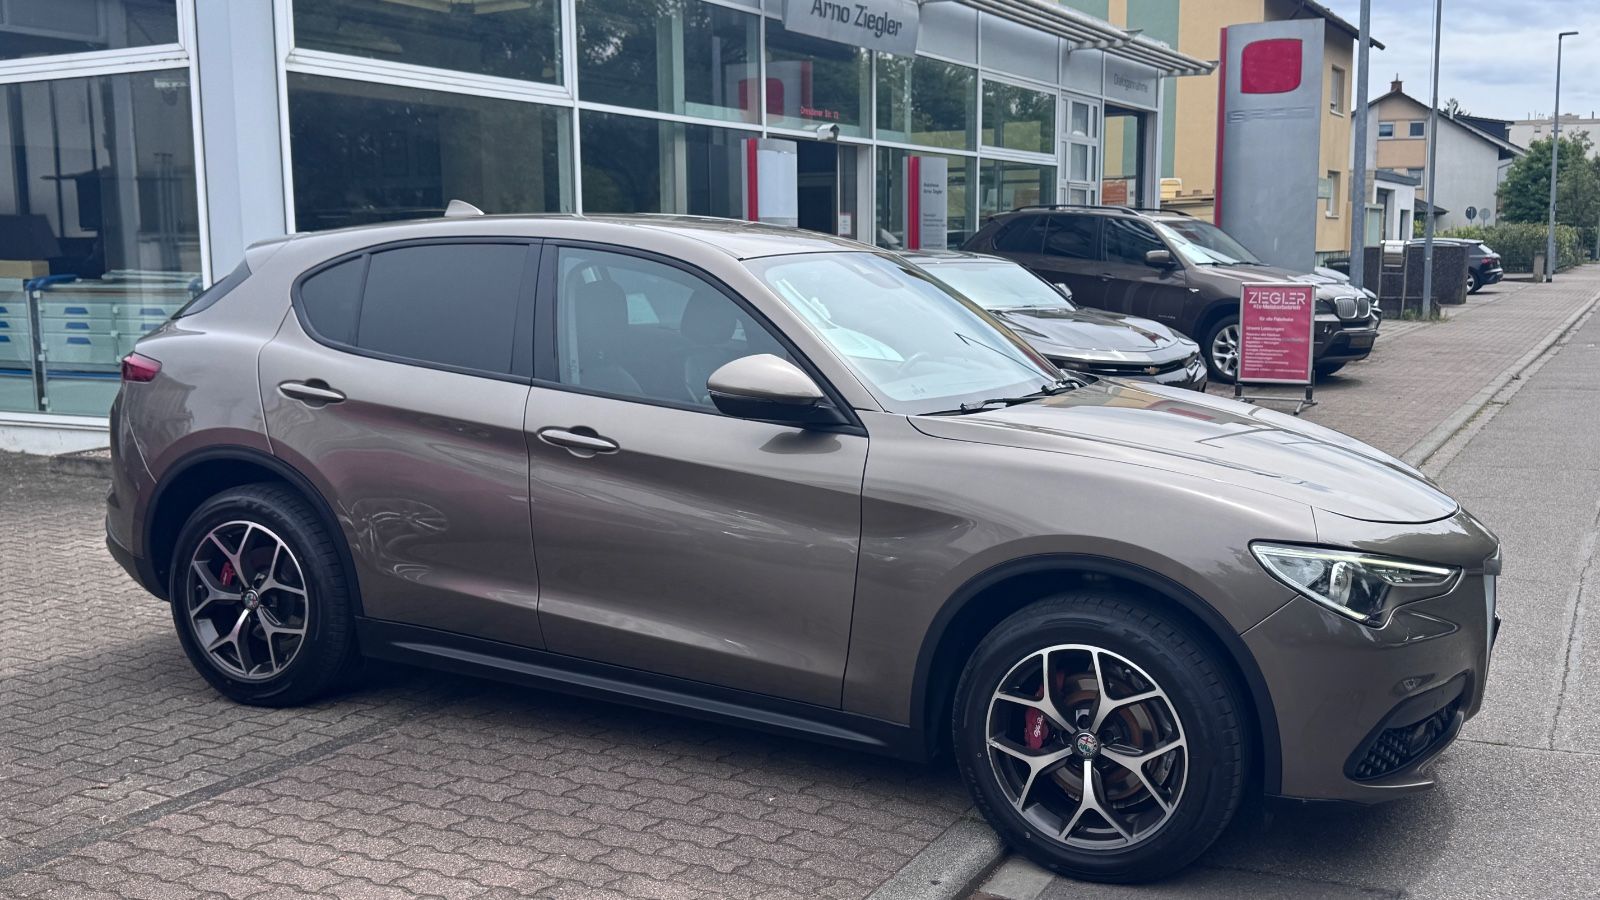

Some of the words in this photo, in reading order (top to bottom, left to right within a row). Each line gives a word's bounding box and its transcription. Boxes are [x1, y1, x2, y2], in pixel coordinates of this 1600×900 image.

[810, 0, 850, 23] Arno
[854, 4, 903, 38] Ziegler
[1248, 291, 1306, 305] ZIEGLER
